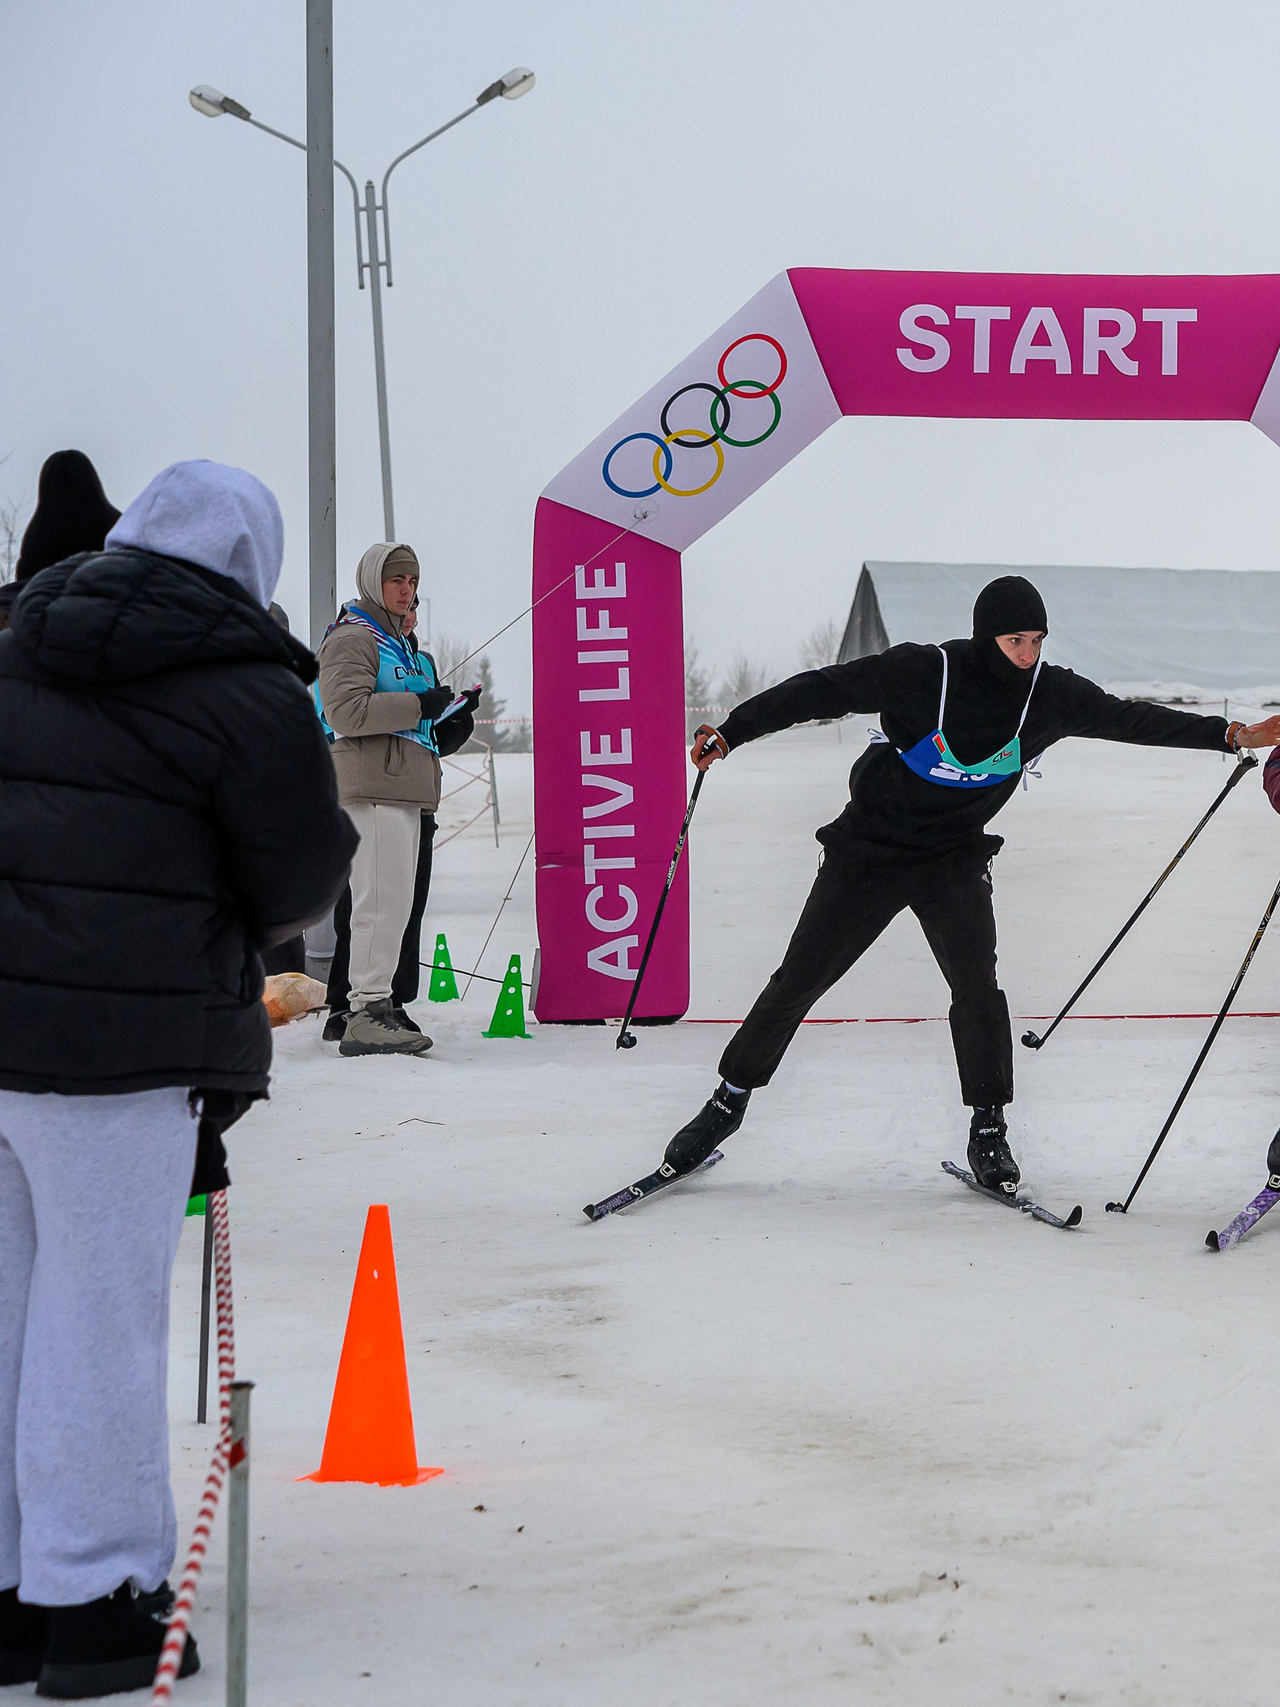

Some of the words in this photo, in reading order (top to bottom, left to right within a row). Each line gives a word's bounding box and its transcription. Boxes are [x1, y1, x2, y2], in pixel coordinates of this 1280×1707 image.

[896, 303, 1199, 377] START
[574, 562, 632, 703] LIFE
[579, 728, 639, 982] ACTIVE
